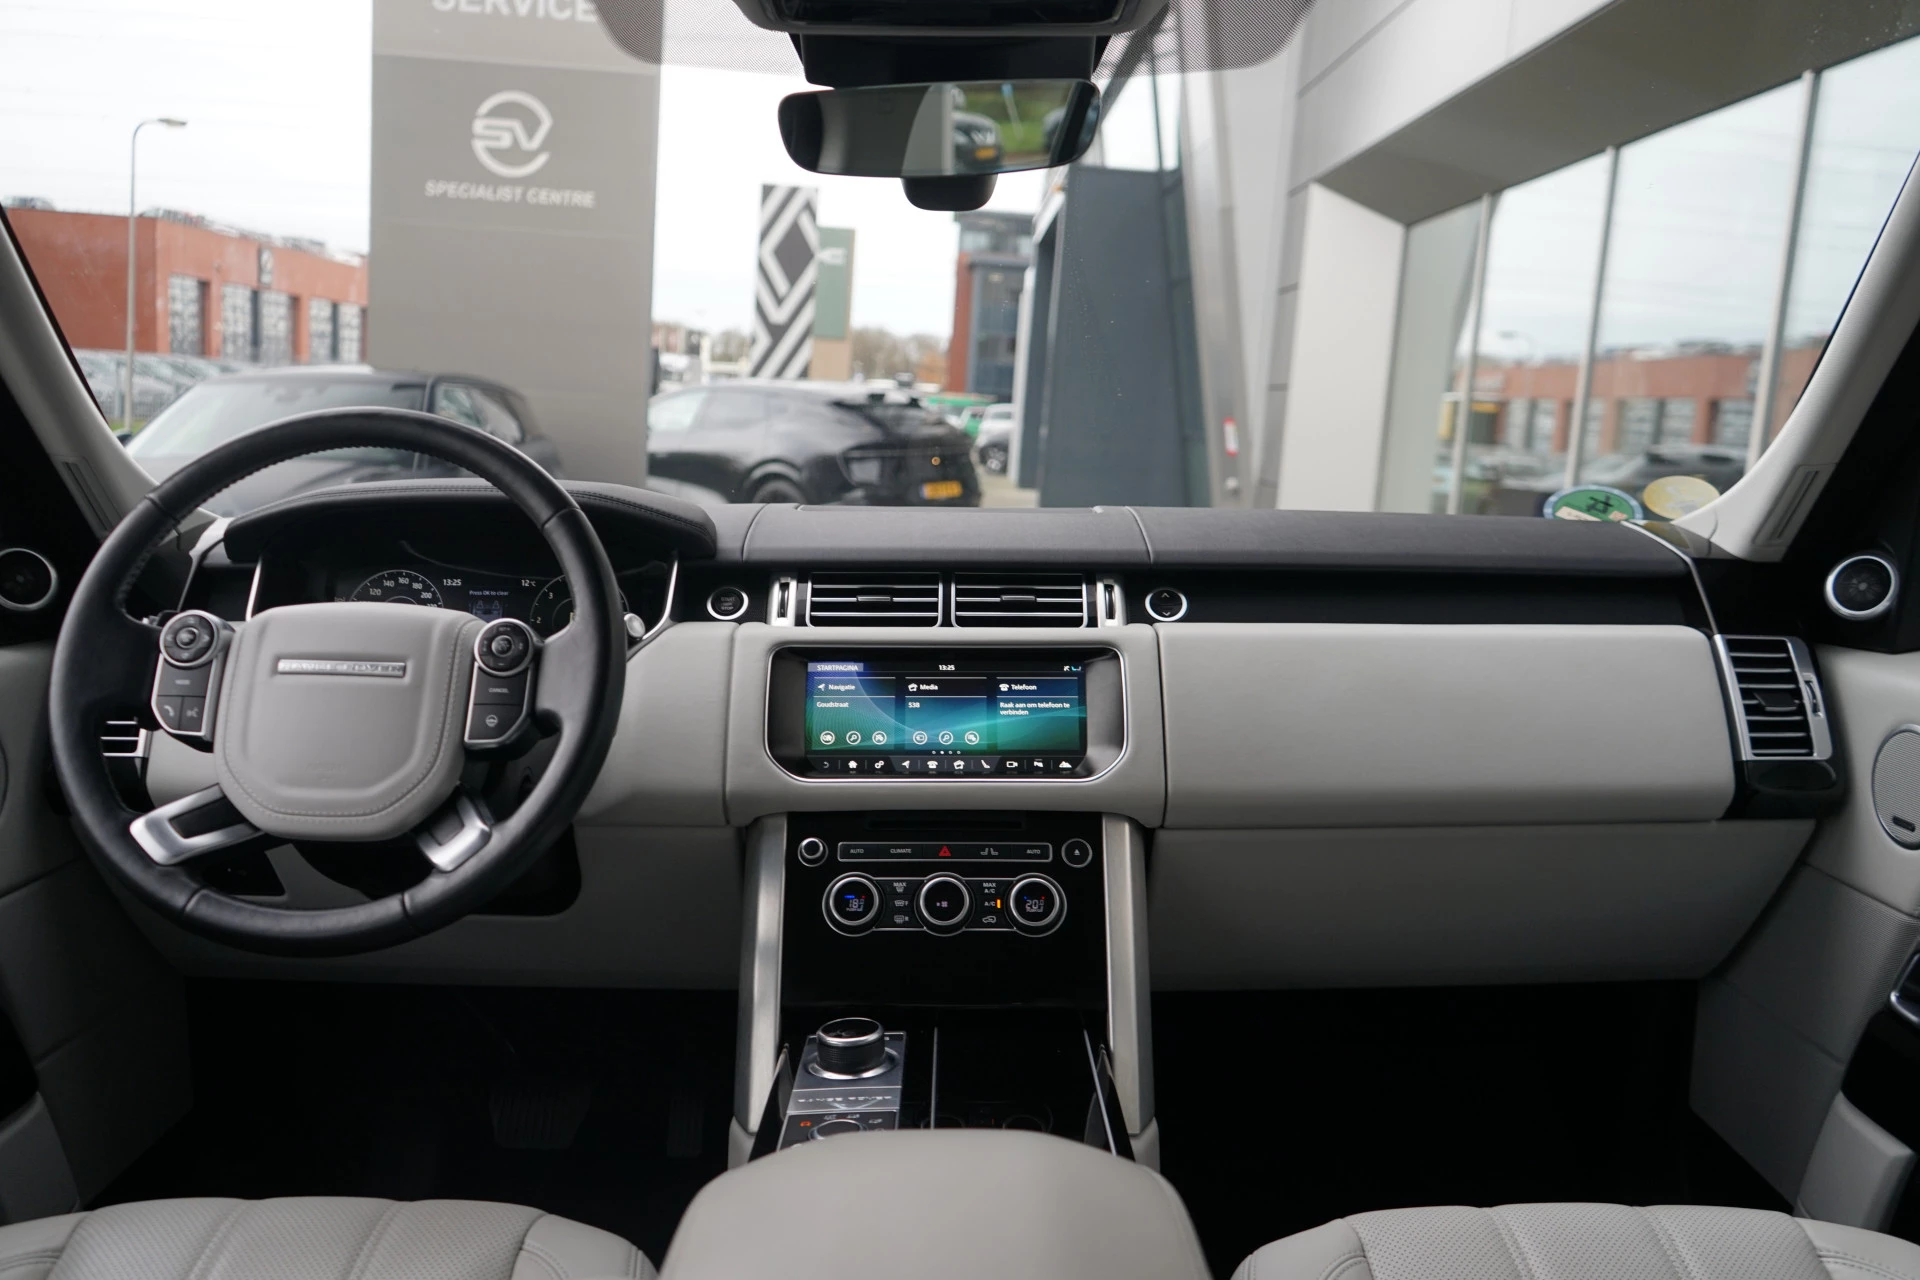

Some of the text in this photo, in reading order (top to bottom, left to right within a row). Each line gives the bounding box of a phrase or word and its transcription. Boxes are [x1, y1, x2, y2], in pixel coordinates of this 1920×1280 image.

[424, 180, 597, 208] SPECIALIST CENTRE
[382, 579, 395, 587] 140
[369, 588, 382, 596] 120
[816, 664, 859, 672] STARTPAGINA
[828, 684, 856, 692] Navigatie
